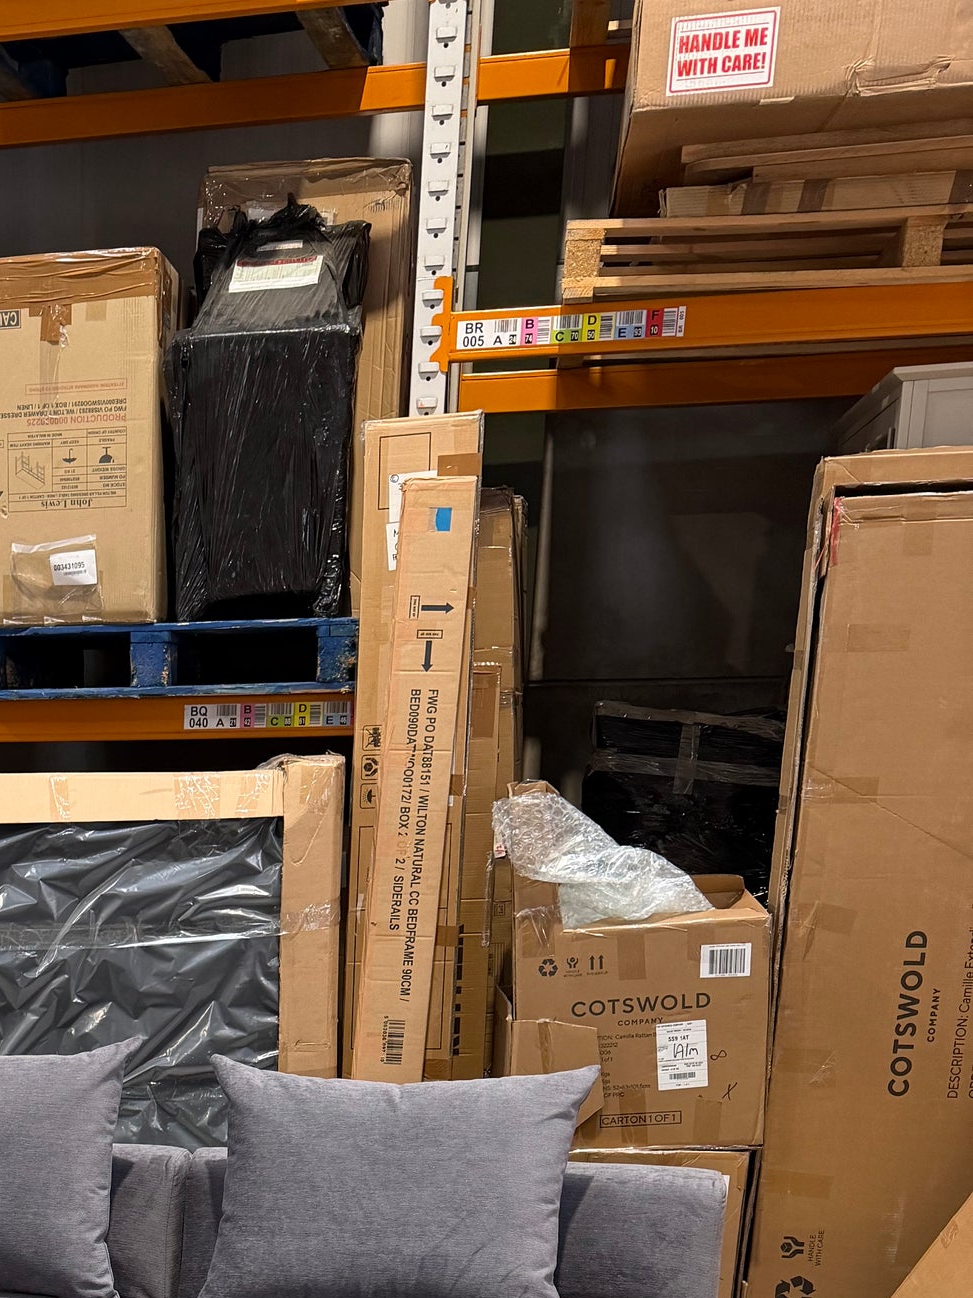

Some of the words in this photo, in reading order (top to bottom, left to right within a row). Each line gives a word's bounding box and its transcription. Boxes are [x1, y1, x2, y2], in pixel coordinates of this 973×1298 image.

[679, 30, 741, 54] HANDLE
[744, 27, 769, 47] ME
[677, 57, 718, 77] WITH
[721, 52, 766, 73] CARE!
[588, 315, 596, 325] D
[652, 311, 659, 320] F
[466, 322, 484, 333] BR
[526, 319, 534, 329] B
[555, 332, 564, 341] C
[618, 328, 626, 338] E
[463, 335, 484, 347] 005
[493, 335, 502, 345] A
[71, 413, 126, 424] PRODUCTION
[41, 500, 66, 509] Lewis
[70, 498, 92, 507] John
[299, 704, 307, 713] D
[427, 689, 439, 714] FWG
[190, 706, 208, 717] BQ
[244, 705, 251, 714] B
[189, 718, 208, 728] 040
[216, 719, 224, 727] A
[271, 717, 278, 726] C
[326, 716, 333, 725] E
[425, 718, 437, 733] PO
[420, 736, 435, 786] DAT88151
[399, 806, 411, 830] BOX
[415, 794, 429, 836] WILTON
[410, 838, 425, 888] NATURAL
[389, 876, 404, 931] SIDERAILS
[407, 891, 420, 906] CC
[403, 908, 419, 967] BEDFRAME
[399, 969, 413, 996] 90CM
[571, 992, 711, 1017] COTSWOLD
[618, 1017, 663, 1026] COMPANY
[887, 931, 927, 1097] COTSWOLD
[927, 988, 941, 1042] COMPANY
[947, 1015, 969, 1099] DESCRIPTION:
[959, 973, 973, 1013] Camille
[602, 1115, 646, 1126] CARTON
[655, 1114, 669, 1122] OF
[817, 1230, 825, 1248] CARE
[808, 1235, 816, 1261] HANDLE
[815, 1249, 823, 1266] WITH
